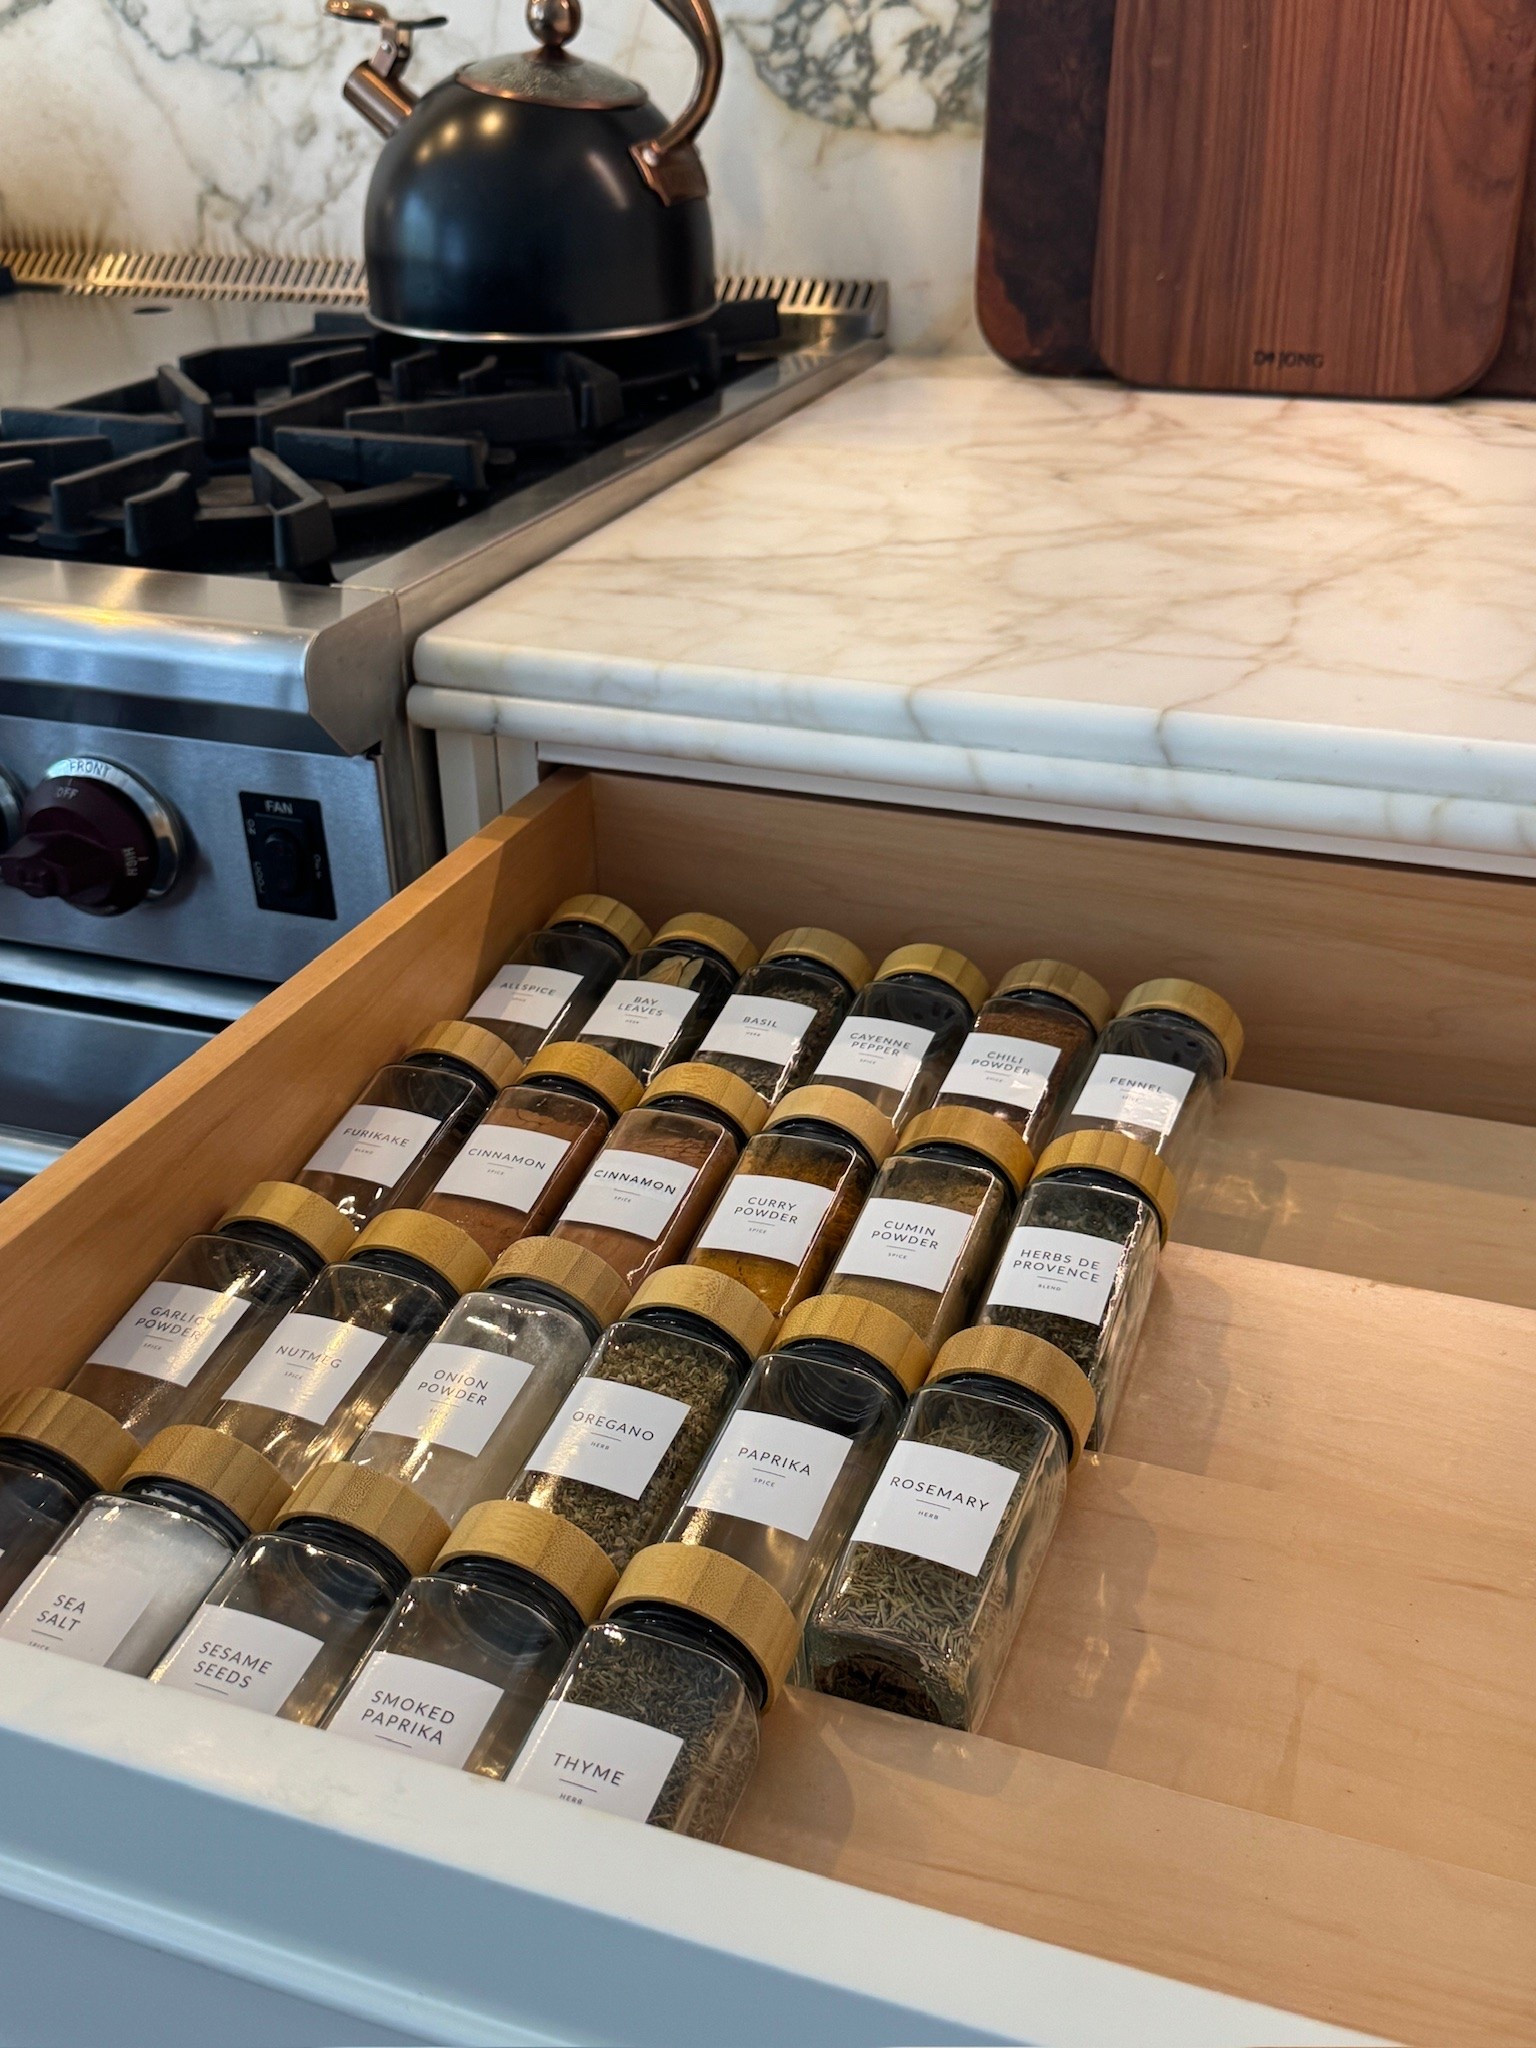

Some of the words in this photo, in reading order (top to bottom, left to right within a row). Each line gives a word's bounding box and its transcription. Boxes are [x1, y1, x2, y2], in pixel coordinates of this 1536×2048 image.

[69, 761, 110, 778] FRONT
[56, 787, 79, 800] OFF
[265, 800, 294, 815] FAN
[122, 847, 138, 877] HIGH
[500, 981, 556, 996] ALLSPICE
[617, 1003, 664, 1017] LEAVES
[634, 996, 659, 1007] BAY
[742, 1016, 778, 1029] BASIL
[850, 1032, 912, 1050] CAYENNE
[851, 1041, 901, 1057] PEPPER
[971, 1058, 1031, 1076] POWDER
[987, 1051, 1024, 1064] CHILI
[1109, 1076, 1162, 1094] FENNEL
[343, 1127, 410, 1148] FURIKAKE
[468, 1147, 547, 1170] CINNAMON
[593, 1169, 677, 1195] CINNAMON
[747, 1196, 798, 1212] CURRY
[734, 1206, 798, 1225] POWDER
[748, 1227, 767, 1235] SPICE
[883, 1220, 937, 1237] CUMIN
[871, 1230, 939, 1250] POWDER
[888, 1252, 908, 1260] SPICE
[1020, 1248, 1072, 1264] HERBS
[1078, 1257, 1101, 1271] DE
[1013, 1259, 1101, 1283] PROVENCE
[1038, 1283, 1062, 1292] BLEND
[151, 1306, 205, 1326] GARLIC
[134, 1317, 201, 1340] POWDER
[275, 1345, 342, 1369] NUTMEG
[433, 1369, 488, 1390] ONION
[417, 1381, 488, 1406] POWDER
[572, 1410, 655, 1442] OREGANO
[590, 1440, 610, 1450] HERB
[737, 1446, 812, 1477] PAPRIKA
[753, 1477, 776, 1488] SPICE
[889, 1475, 990, 1513] ROSEMARY
[917, 1510, 939, 1521] HERB
[52, 1593, 87, 1615] SEA
[36, 1609, 82, 1632] SALT
[197, 1640, 273, 1676] SESAME
[193, 1660, 253, 1690] SEEDS
[371, 1689, 456, 1726] SMOKED
[361, 1708, 444, 1746] PAPRIKA
[553, 1752, 625, 1787] THYME
[559, 1793, 583, 1805] HERB
